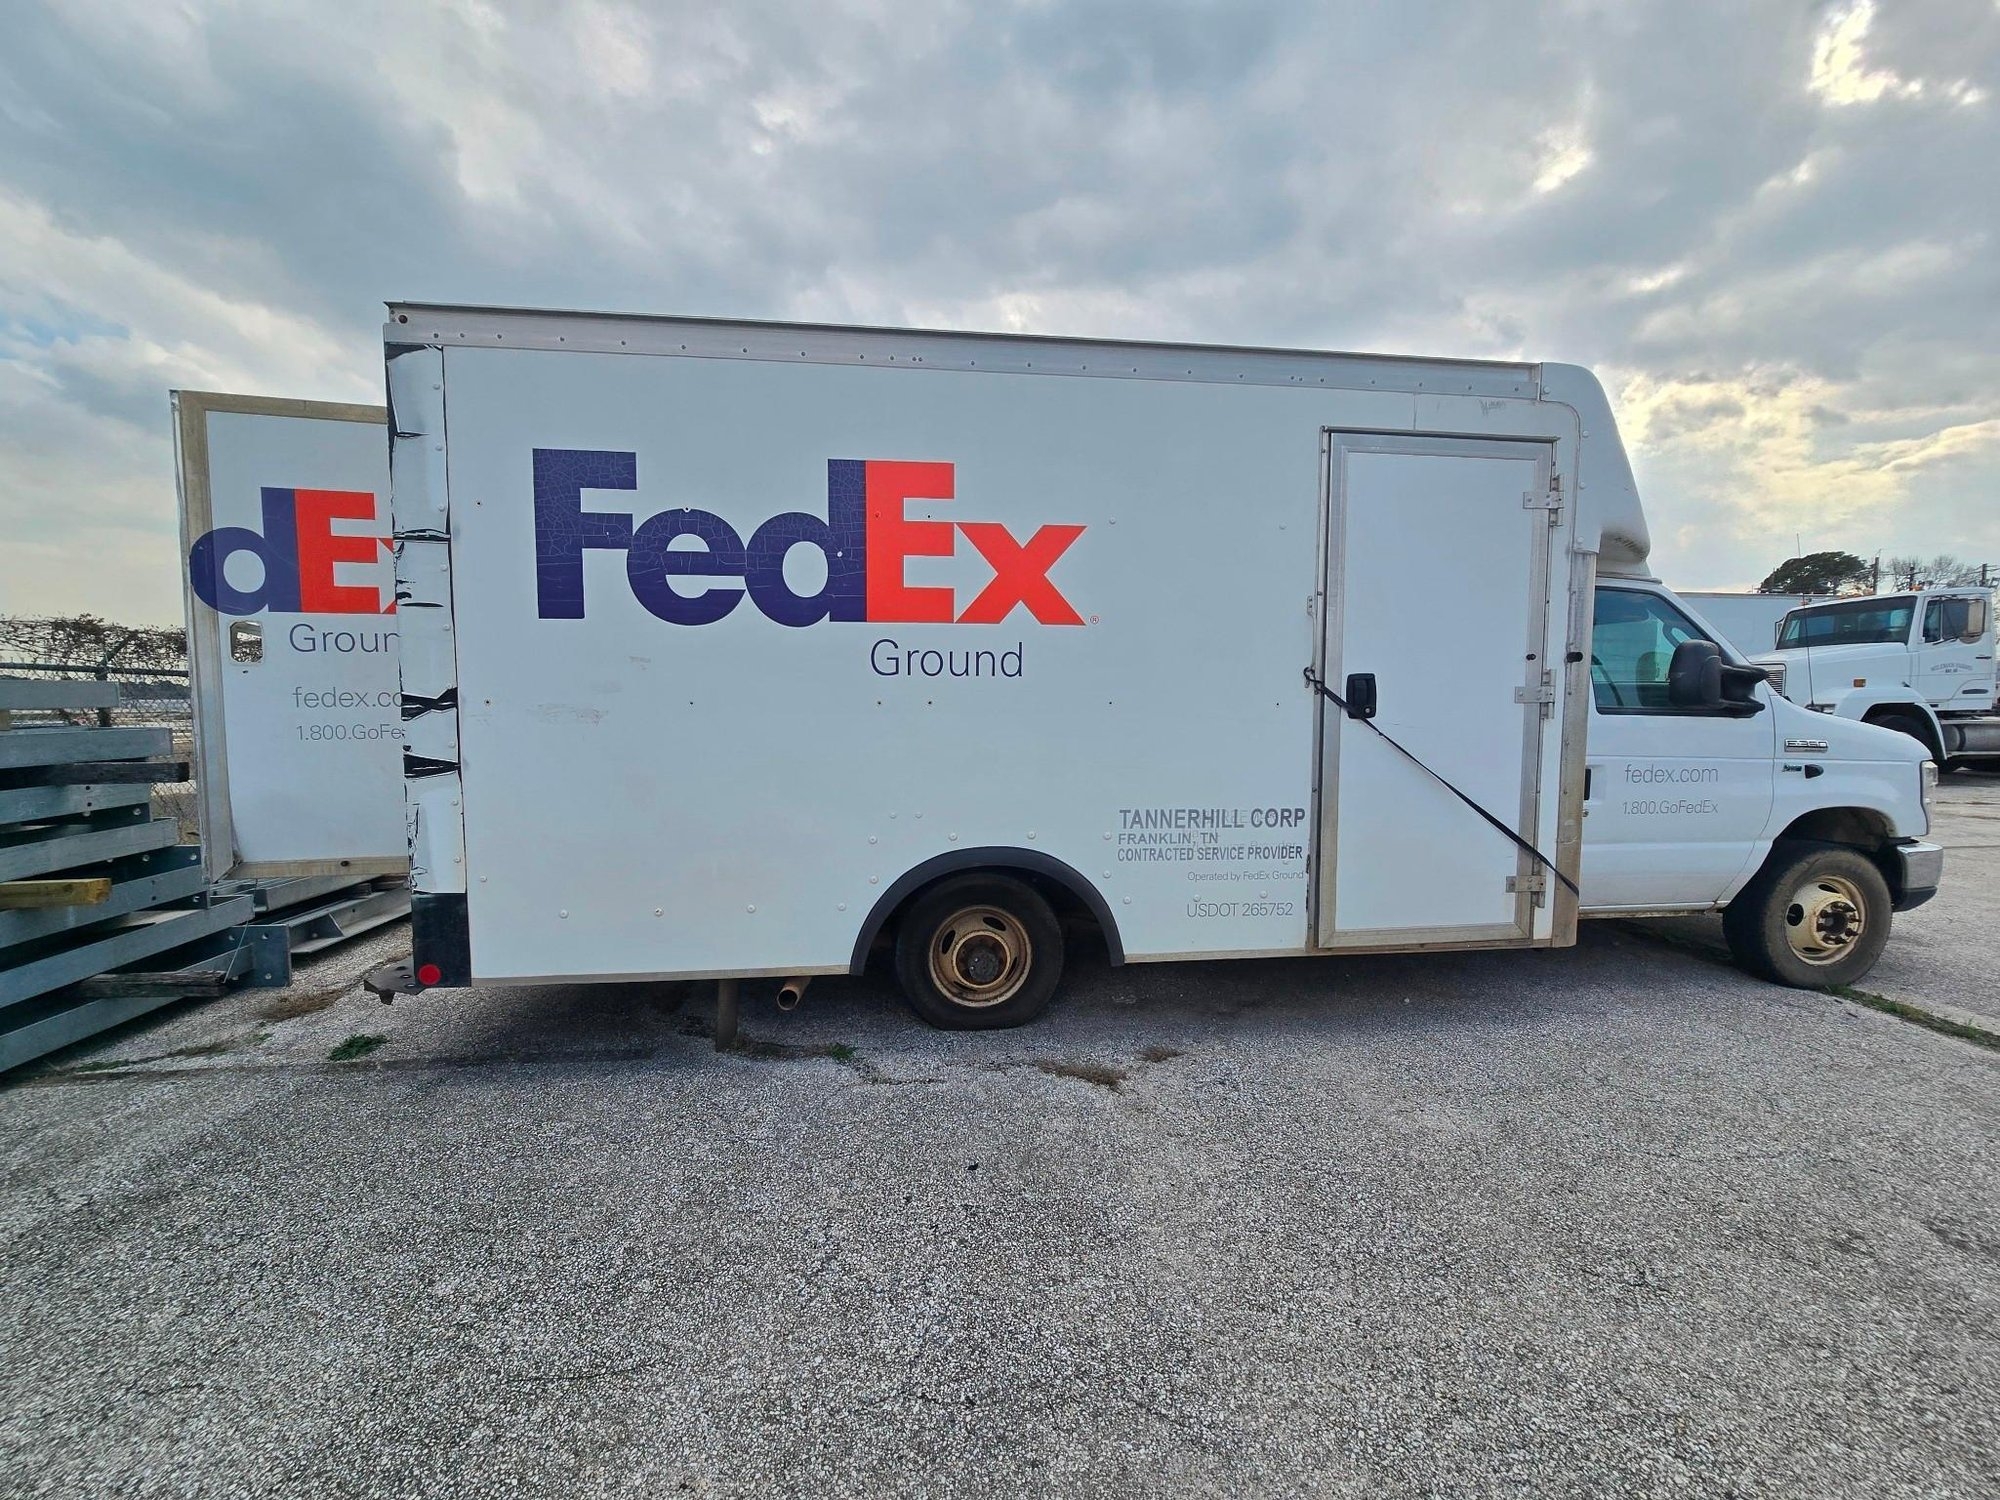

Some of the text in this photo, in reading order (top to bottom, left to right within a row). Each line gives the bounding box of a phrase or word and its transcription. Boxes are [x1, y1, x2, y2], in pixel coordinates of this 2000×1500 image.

[532, 448, 1088, 628] FedEx
[189, 487, 397, 616] dE
[870, 638, 1024, 678] Ground
[1624, 763, 1719, 783] fedex.com
[1622, 799, 1719, 815] 1.800.GoFedEx
[1119, 807, 1306, 829] TANNERHILL CORP
[1117, 832, 1219, 846] FRANKLIN, TN
[1117, 845, 1303, 862] CONTRACTED SERVICE PROVIDER
[1187, 870, 1304, 882] Operated by FedEx Ground
[1186, 902, 1294, 917] USDOT 265752
